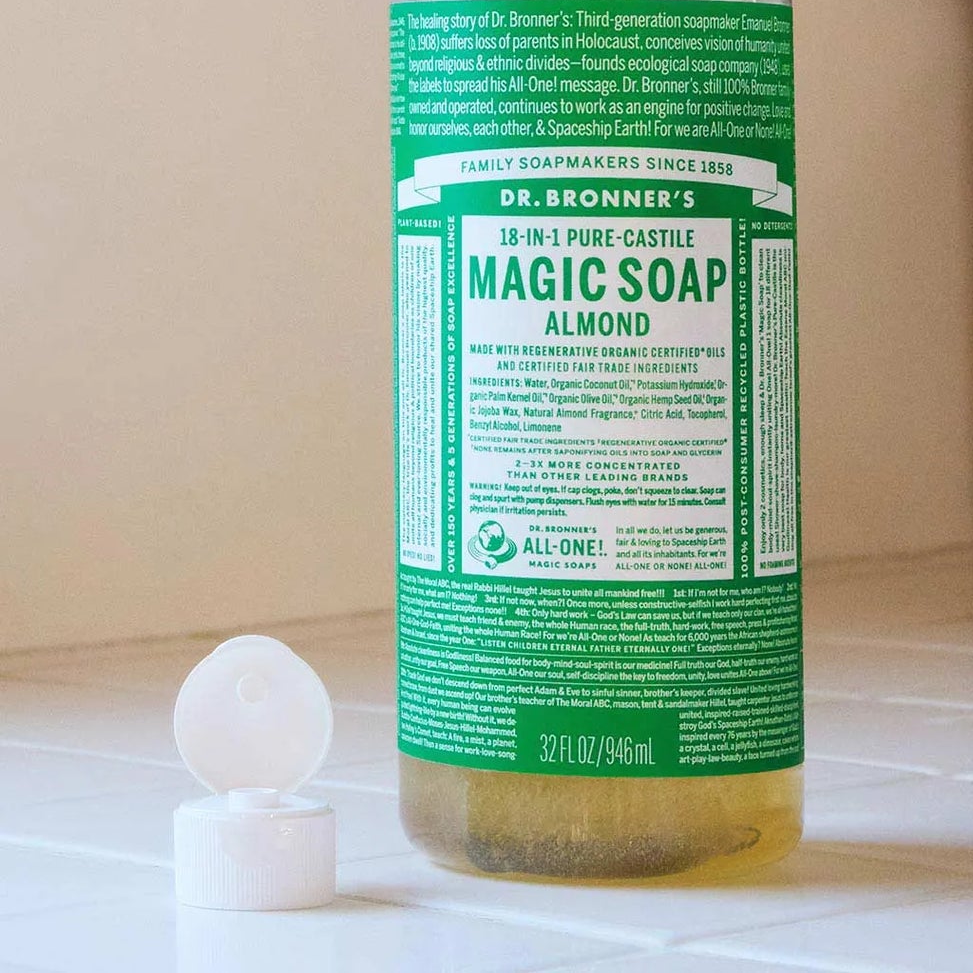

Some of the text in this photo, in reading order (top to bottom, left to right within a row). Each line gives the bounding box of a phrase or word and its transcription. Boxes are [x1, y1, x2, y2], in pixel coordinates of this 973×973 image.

[419, 13, 449, 32] healing
[450, 12, 476, 31] story
[477, 11, 489, 27] of
[491, 11, 506, 27] Dr.
[509, 10, 572, 27] Bronner's:
[576, 10, 680, 30] Third-generation
[683, 13, 740, 31] soapmaker
[440, 32, 743, 52] suffers loss of parents in Holocaust, conceives vision of
[434, 55, 474, 74] religious
[475, 54, 485, 70] &
[486, 55, 523, 70] ethnic
[627, 55, 688, 75] ecological
[691, 59, 716, 75] soap
[718, 60, 757, 77] company
[442, 75, 750, 96] to spread his All-One! message. Dr. Bronner's, still 100%
[428, 118, 672, 139] ourselves, each other, & Spaceship Earth! For
[461, 155, 732, 175] FAMILY SOAPMAKERS SINCE 1858
[500, 188, 694, 208] DR. BRONNER'S
[500, 227, 694, 247] 18-IN-1 PURE-CASTILE
[447, 215, 455, 294] EXCELLENCE
[469, 255, 726, 302] MAGIC SOAP
[447, 298, 455, 331] SOAP
[544, 310, 649, 336] ALMOND
[447, 334, 455, 350] OF
[470, 344, 492, 354] MADE
[495, 344, 519, 354] WITH
[522, 345, 597, 356] REGENERATIVE
[601, 346, 647, 357] ORGANIC
[706, 346, 724, 357] OILS
[497, 360, 697, 373] AND CERTIFIED FAIR TRADE INGREDIENTS
[739, 342, 747, 411] RECYCLED
[524, 378, 548, 388] Water,
[550, 378, 582, 390] Organic
[583, 378, 617, 389] Coconut
[447, 355, 455, 442] GENERATIONS
[507, 470, 536, 479] THAN
[541, 472, 579, 480] OTHER
[642, 473, 687, 481] BRANDS
[548, 460, 580, 468] MORE
[585, 461, 680, 470] CONCENTRATED
[447, 470, 455, 510] YEARS
[528, 560, 596, 569] MAGIC SOAPS
[740, 540, 748, 577] 100%
[540, 733, 557, 762] 32
[560, 735, 575, 763] FL
